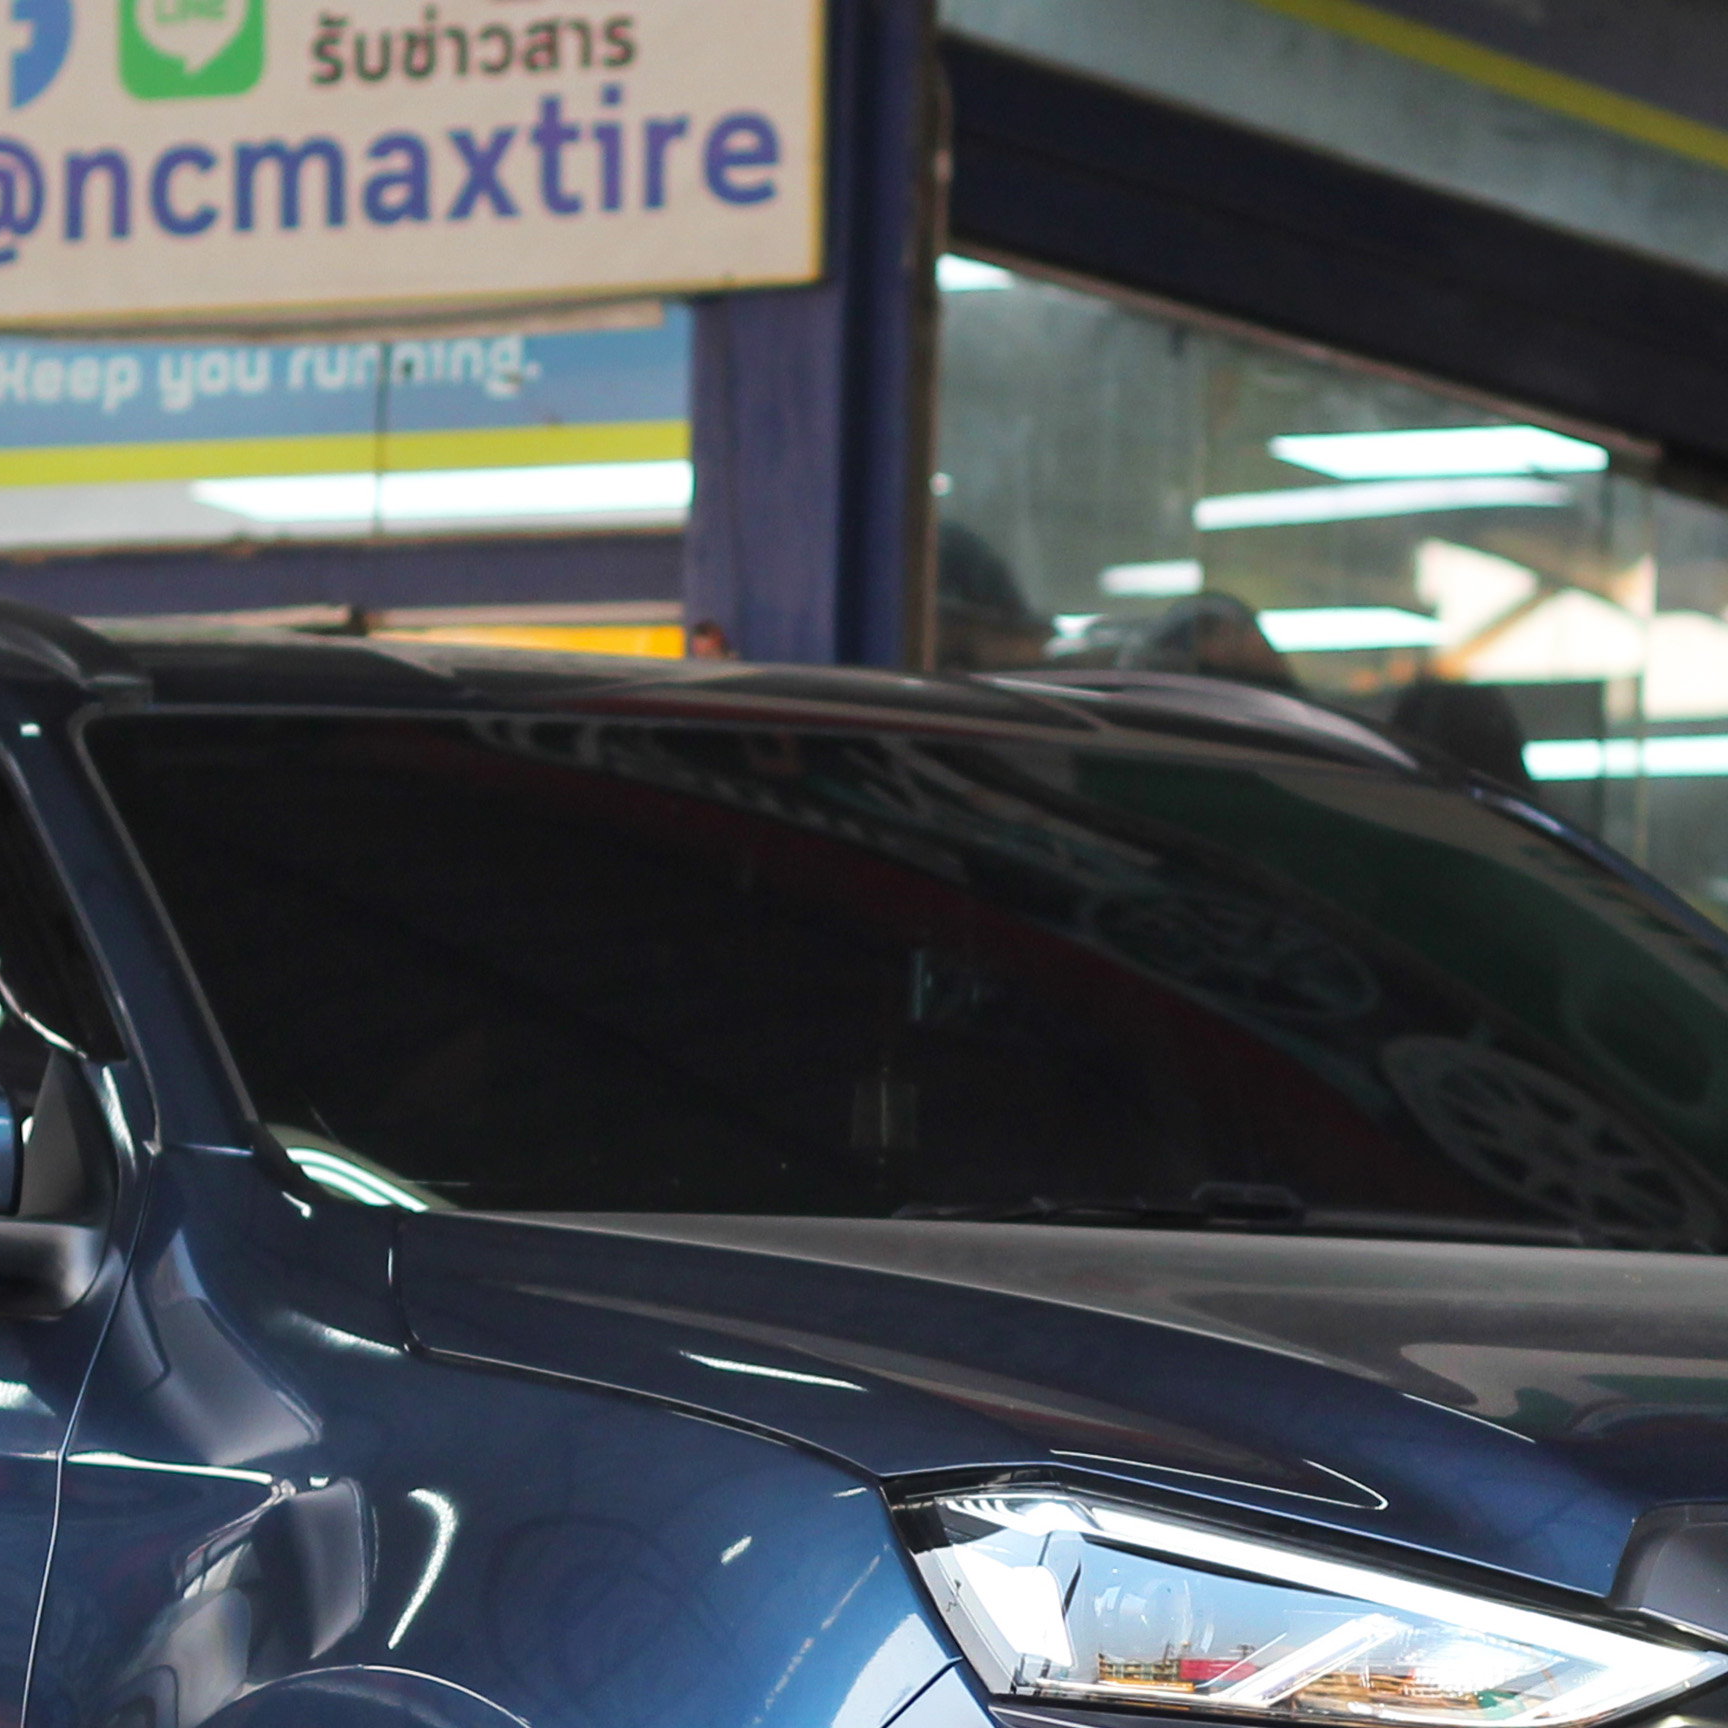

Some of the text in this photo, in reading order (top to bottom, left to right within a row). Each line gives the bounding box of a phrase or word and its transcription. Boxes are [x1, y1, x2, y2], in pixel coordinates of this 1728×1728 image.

[311, 3, 639, 86] รับข่าวสาร
[159, 349, 271, 413] you
